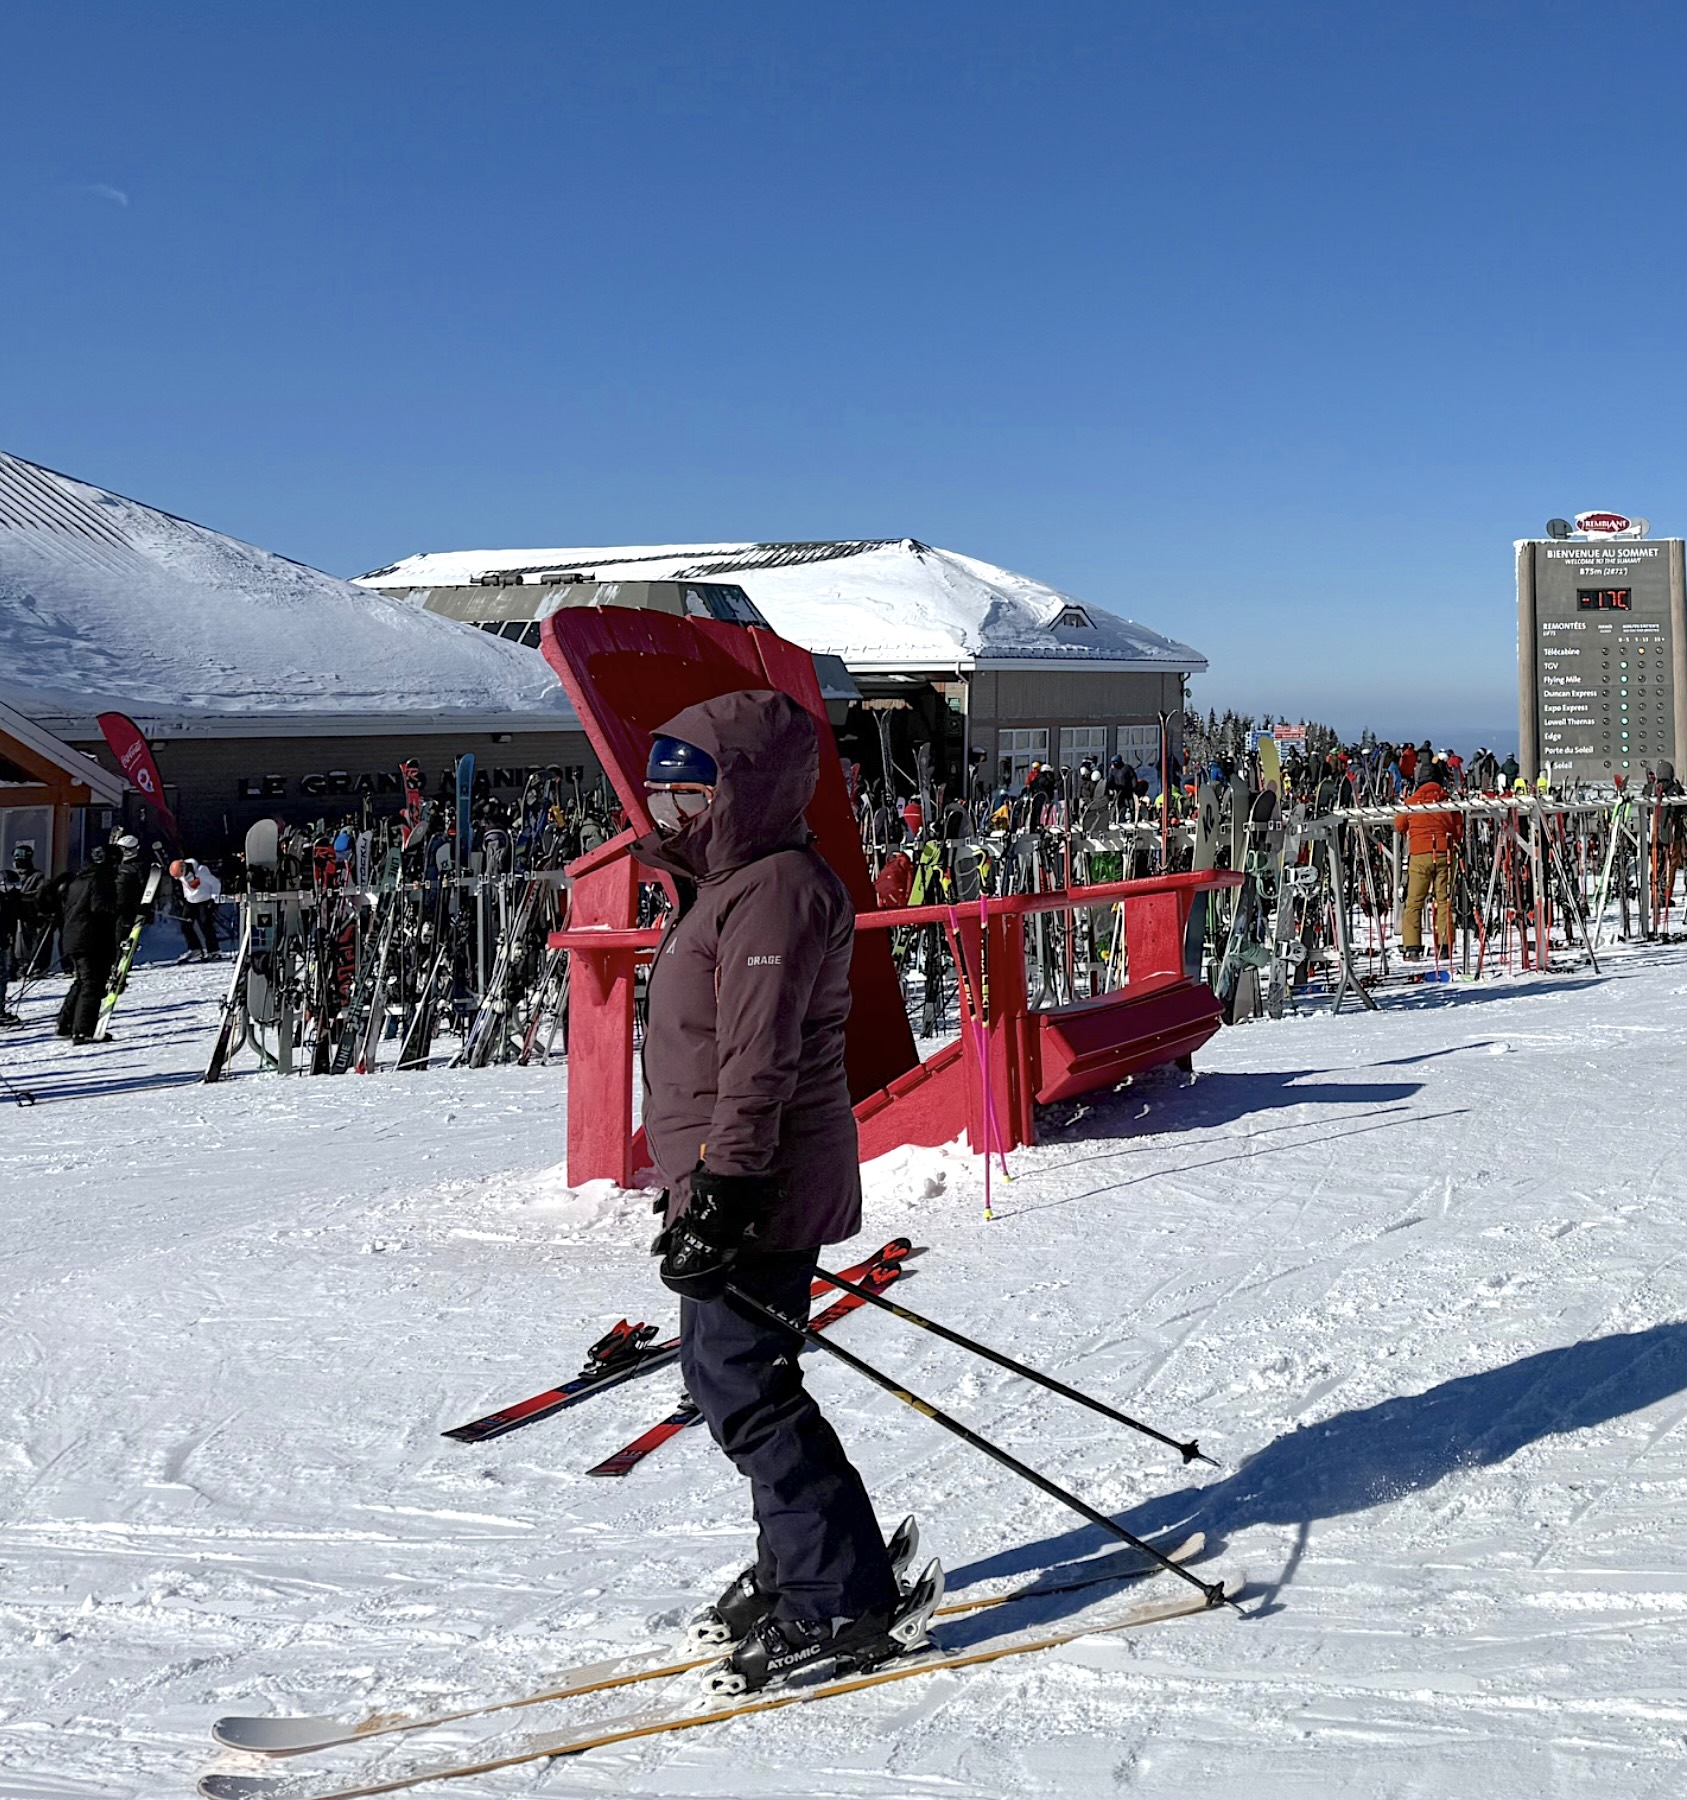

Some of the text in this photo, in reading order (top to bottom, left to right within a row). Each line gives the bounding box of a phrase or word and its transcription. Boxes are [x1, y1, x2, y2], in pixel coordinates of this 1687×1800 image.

[1547, 548, 1659, 558] BIENVENUE AU SOMMET
[1542, 622, 1586, 630] REMONTÉES
[1544, 648, 1580, 656] Télécabine
[1544, 662, 1558, 670] TGV
[1544, 676, 1565, 685] Flying
[1544, 690, 1598, 699] Duncan Express
[1544, 704, 1588, 714] Expo Express
[1544, 732, 1562, 742] Edge
[1544, 746, 1594, 754] Porte du Soleil
[238, 773, 287, 800] LE
[336, 1044, 350, 1068] LINE
[766, 1644, 821, 1671] ATOMIC
